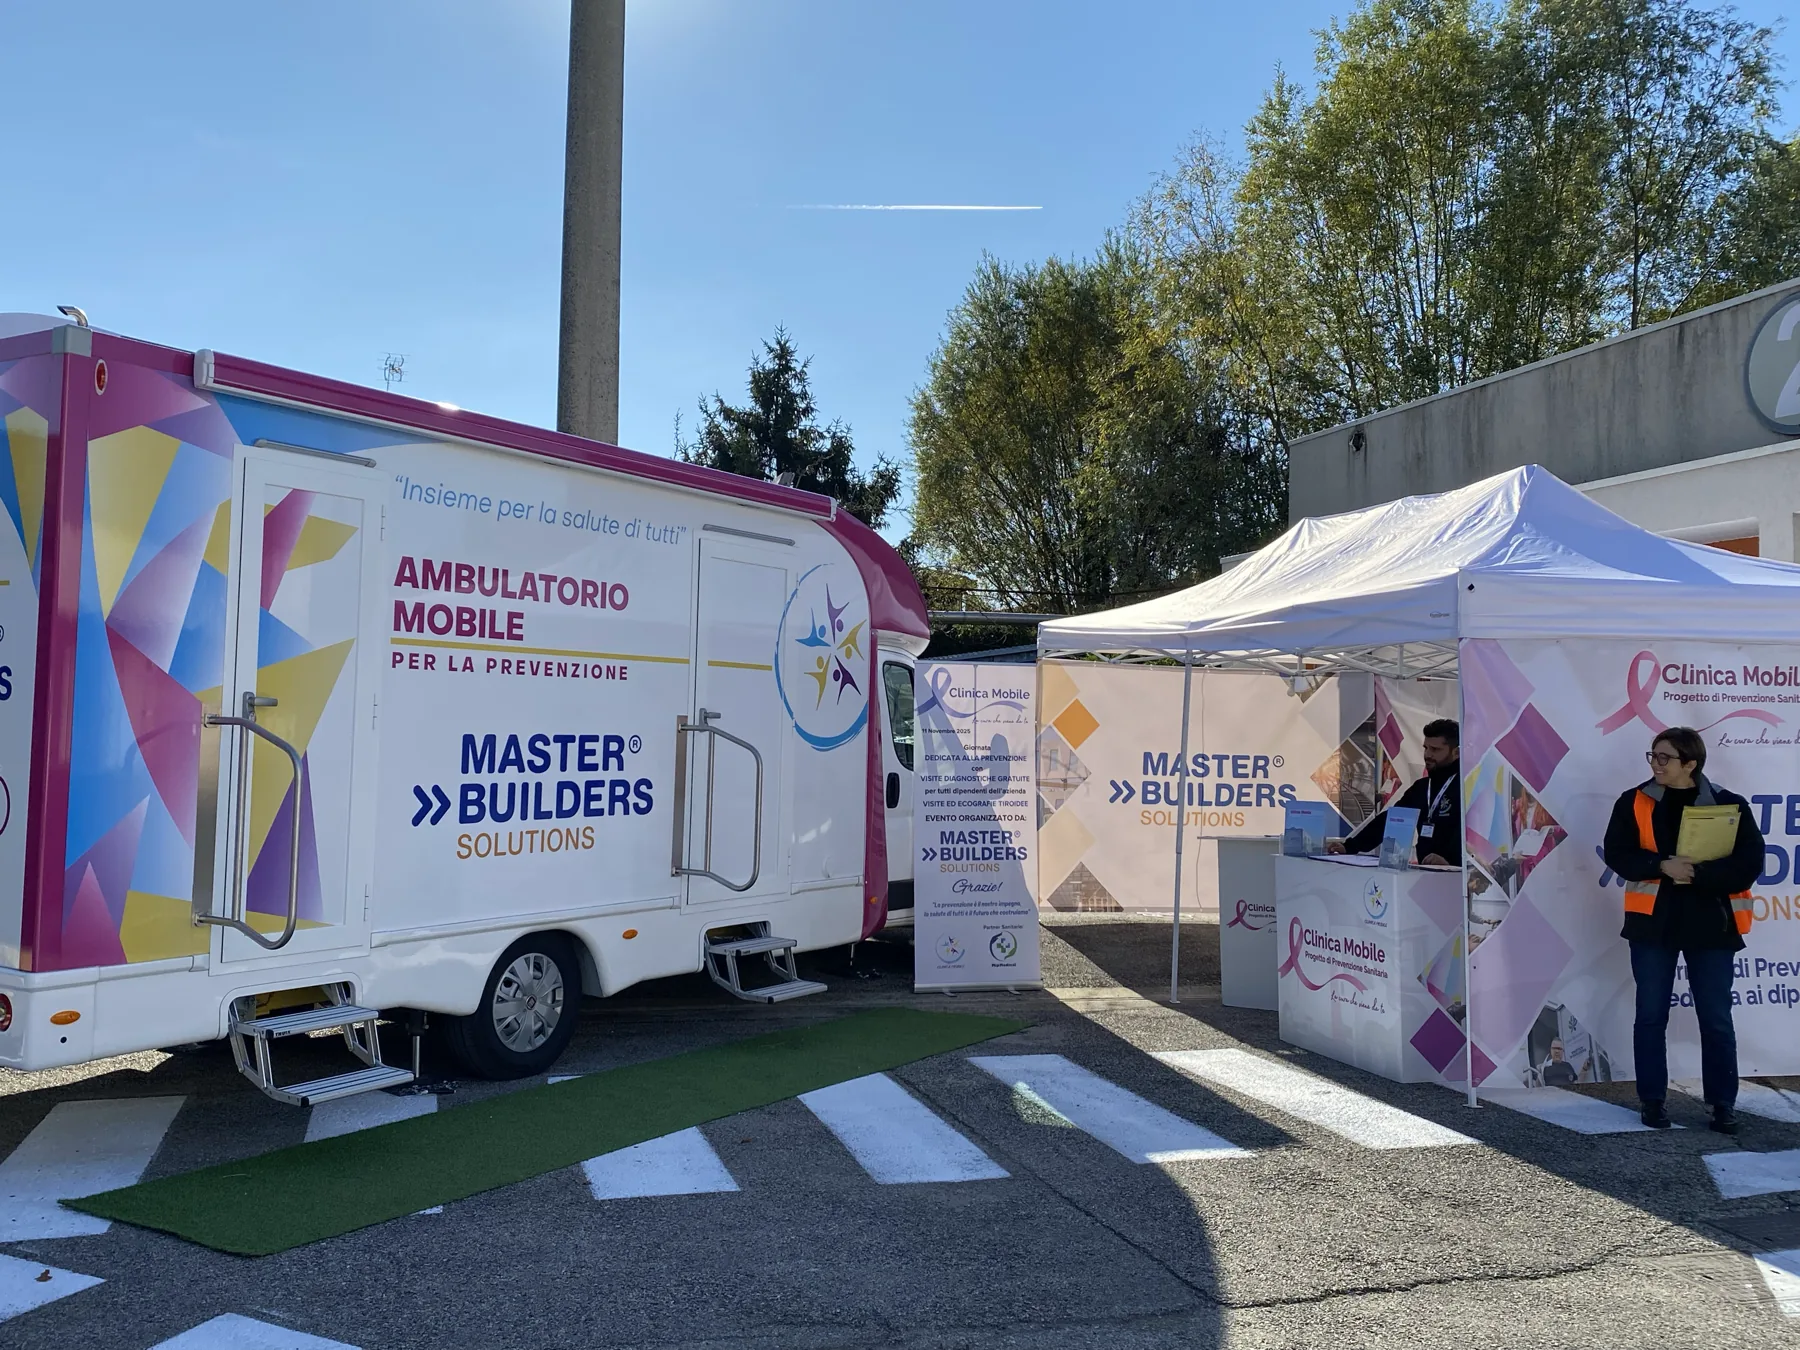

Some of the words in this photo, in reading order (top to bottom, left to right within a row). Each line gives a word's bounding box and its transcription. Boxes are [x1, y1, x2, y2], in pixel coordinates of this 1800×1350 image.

[497, 500, 535, 521] per
[539, 501, 556, 525] la
[562, 509, 619, 535] salute
[625, 518, 640, 539] di
[394, 555, 629, 611] AMBULATORIO
[393, 600, 524, 641] MOBILE
[391, 651, 436, 671] PER
[448, 656, 474, 673] LA
[487, 658, 628, 681] PREVENZIONE
[1662, 663, 1737, 686] Clinica
[1743, 665, 1800, 687] Mobil
[949, 687, 988, 699] Clinica
[992, 688, 1030, 700] Mobile
[1663, 691, 1710, 704] Progetto
[1712, 693, 1720, 703] di
[1722, 693, 1776, 703] Prevenzione
[1777, 693, 1800, 704] Sanit
[1718, 732, 1732, 747] La
[1756, 728, 1769, 745] che
[1772, 736, 1792, 746] viene
[458, 777, 654, 824] BUILDERS
[952, 787, 987, 796] dipendenti
[1141, 780, 1297, 808] BUILDERS
[958, 814, 1013, 822] ORGANIZZATO
[1014, 814, 1027, 822] DA:
[456, 826, 595, 860] SOLUTIONS
[940, 846, 1028, 861] BUILDERS
[940, 863, 1000, 873] SOLUTIONS
[952, 878, 1003, 895] Grazie!
[1247, 903, 1276, 912] Clinica
[1304, 928, 1341, 953] Clinica
[1344, 937, 1386, 963] Mobile
[1305, 950, 1326, 963] Progetto
[1326, 956, 1332, 964] di
[1332, 957, 1363, 973] Prevenzione
[1364, 965, 1388, 979] Sanitaria
[1733, 957, 1750, 979] di
[1746, 984, 1763, 1006] ai
